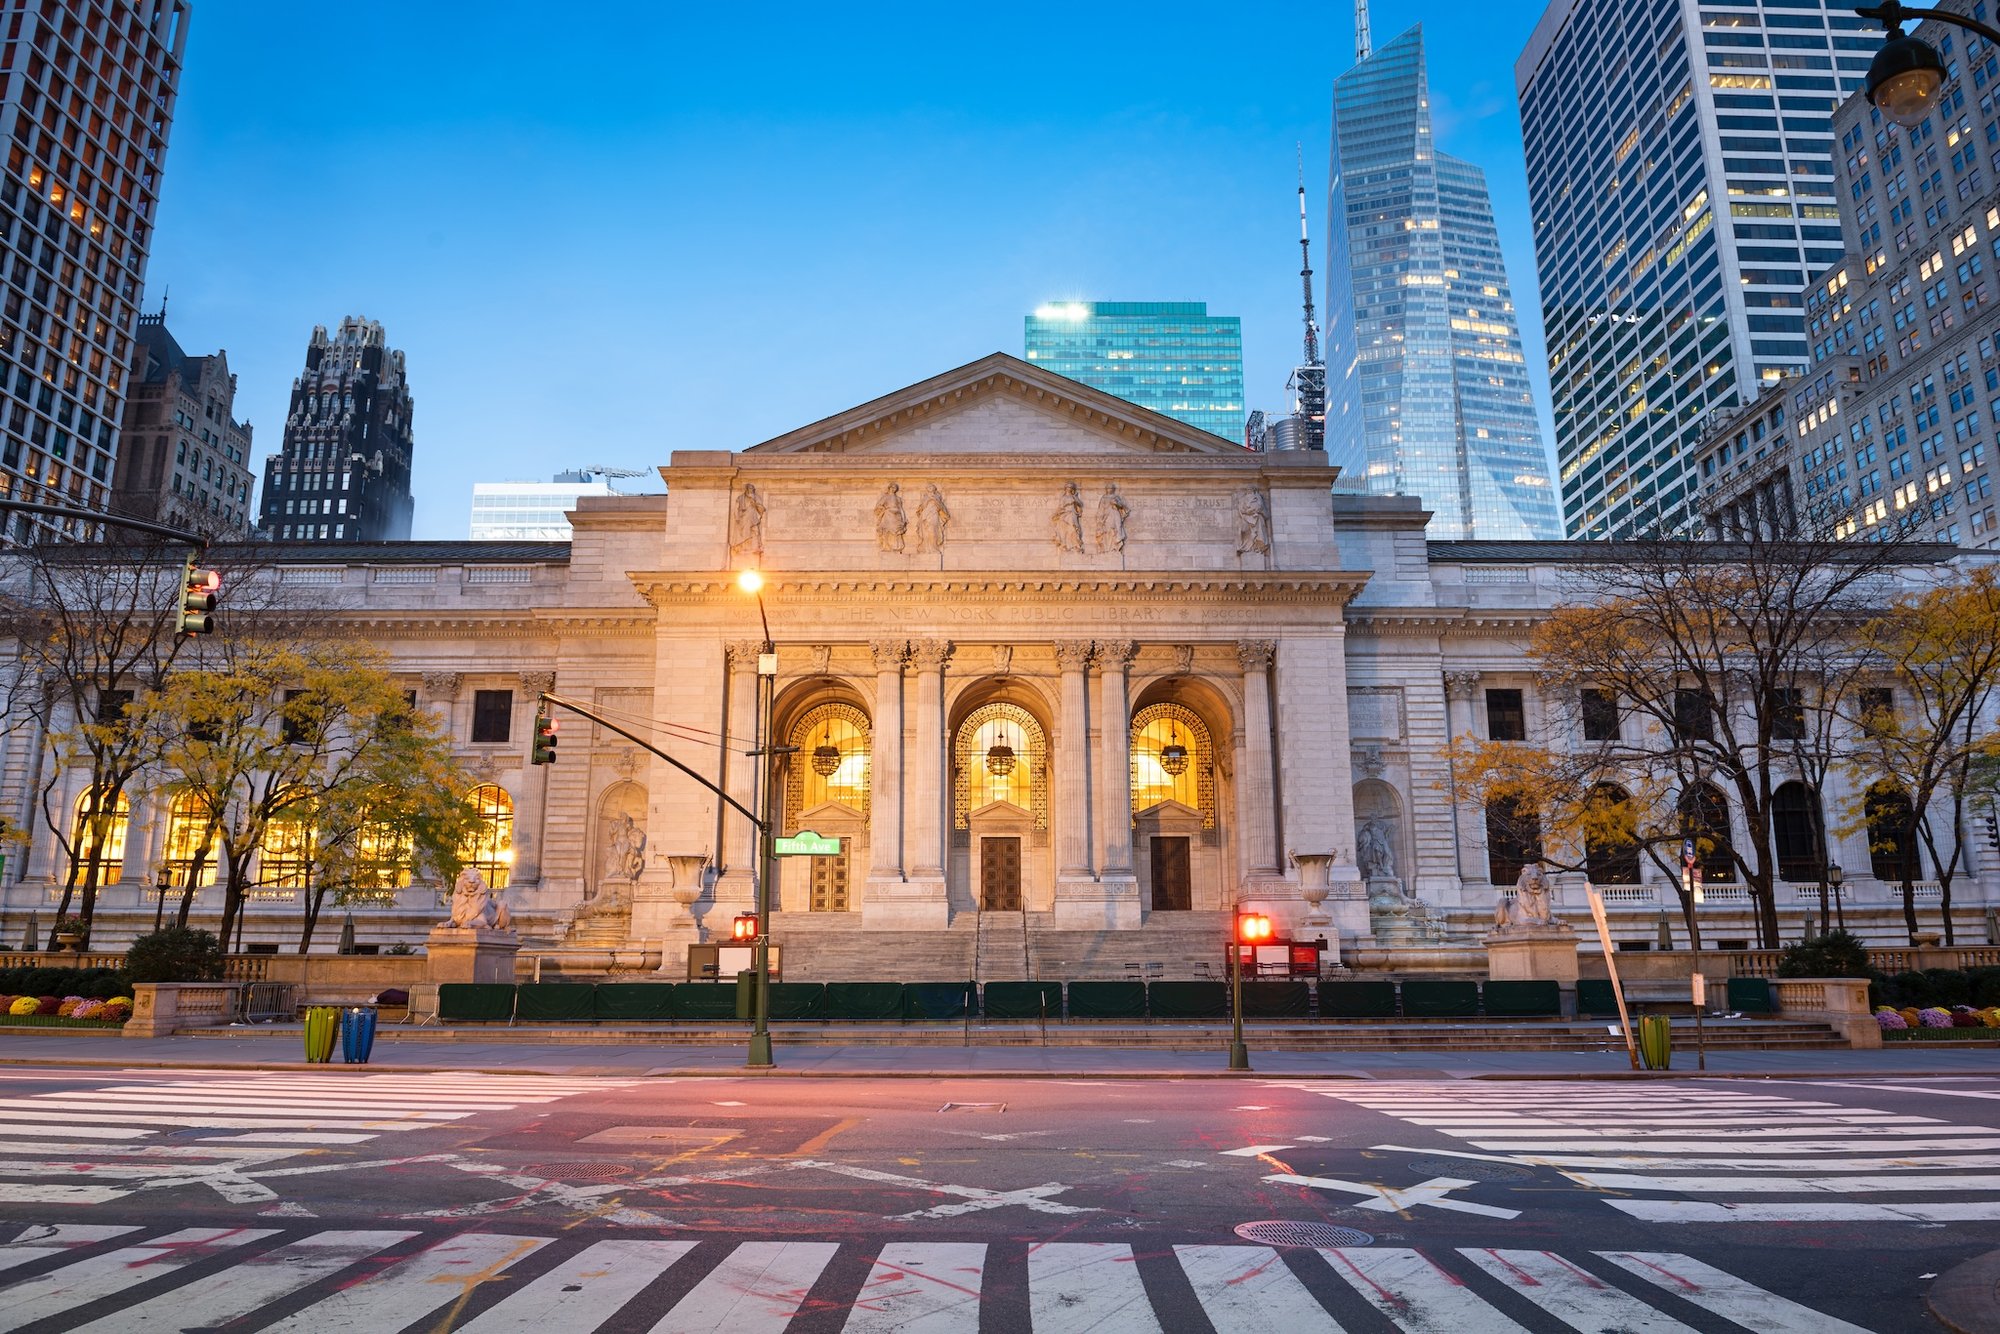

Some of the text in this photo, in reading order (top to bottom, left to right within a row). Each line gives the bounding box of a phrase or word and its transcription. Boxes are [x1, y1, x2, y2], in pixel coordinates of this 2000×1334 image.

[1156, 498, 1189, 508] TILDEN
[839, 607, 875, 620] THE
[889, 607, 933, 620] NEW
[949, 607, 995, 620] YORK
[1011, 607, 1074, 620] PUBLIC
[1090, 607, 1166, 620] LIBRARY
[782, 841, 831, 852] Fifth Ave
